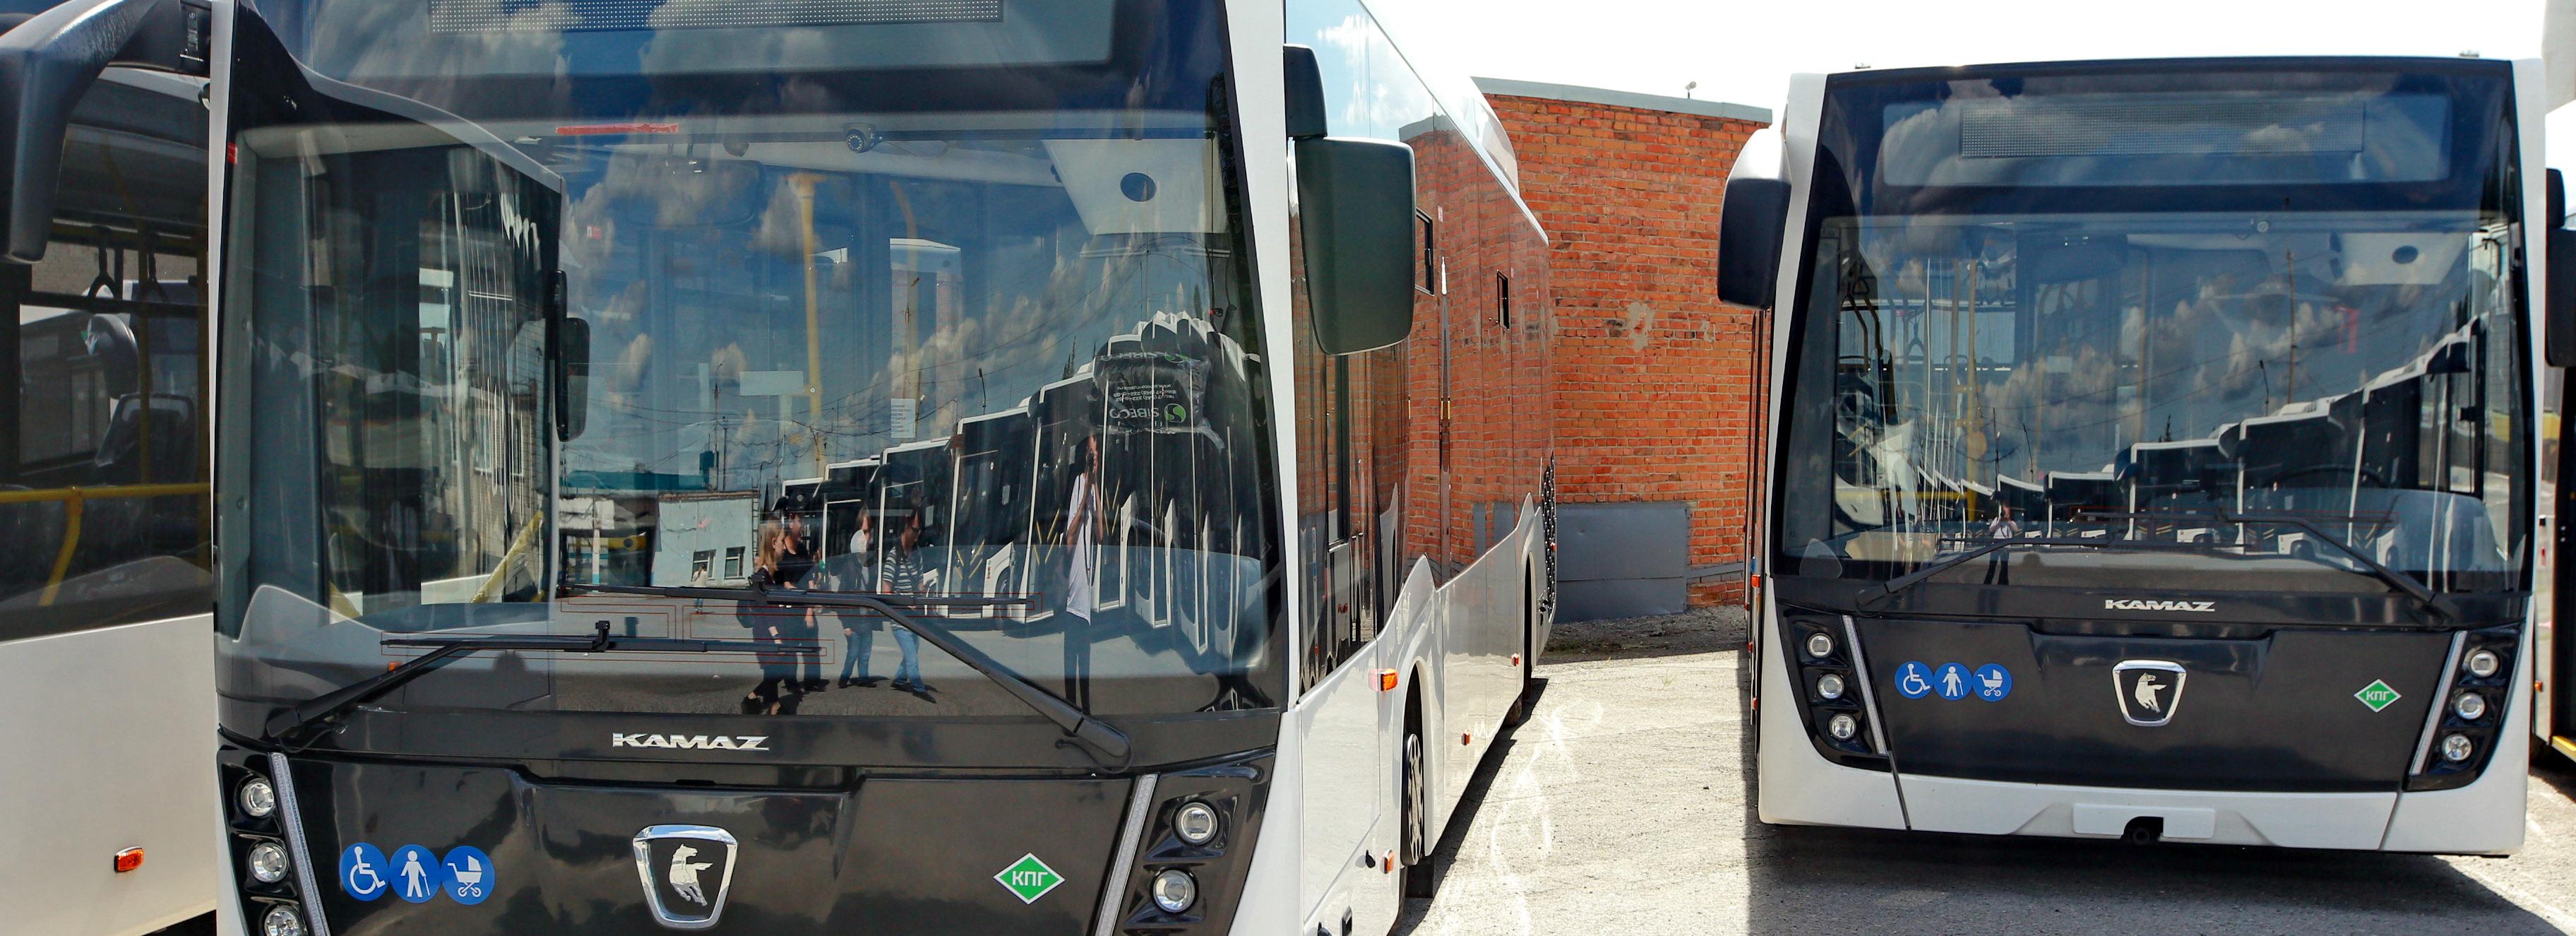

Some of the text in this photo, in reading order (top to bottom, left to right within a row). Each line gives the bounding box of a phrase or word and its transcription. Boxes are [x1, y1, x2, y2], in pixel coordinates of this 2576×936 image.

[1109, 407, 1159, 419] SIBECO
[2105, 600, 2215, 612] KAMAZ
[2366, 691, 2390, 701] КПГ
[612, 733, 769, 751] KAMAZ
[1012, 870, 1049, 887] КПГ
